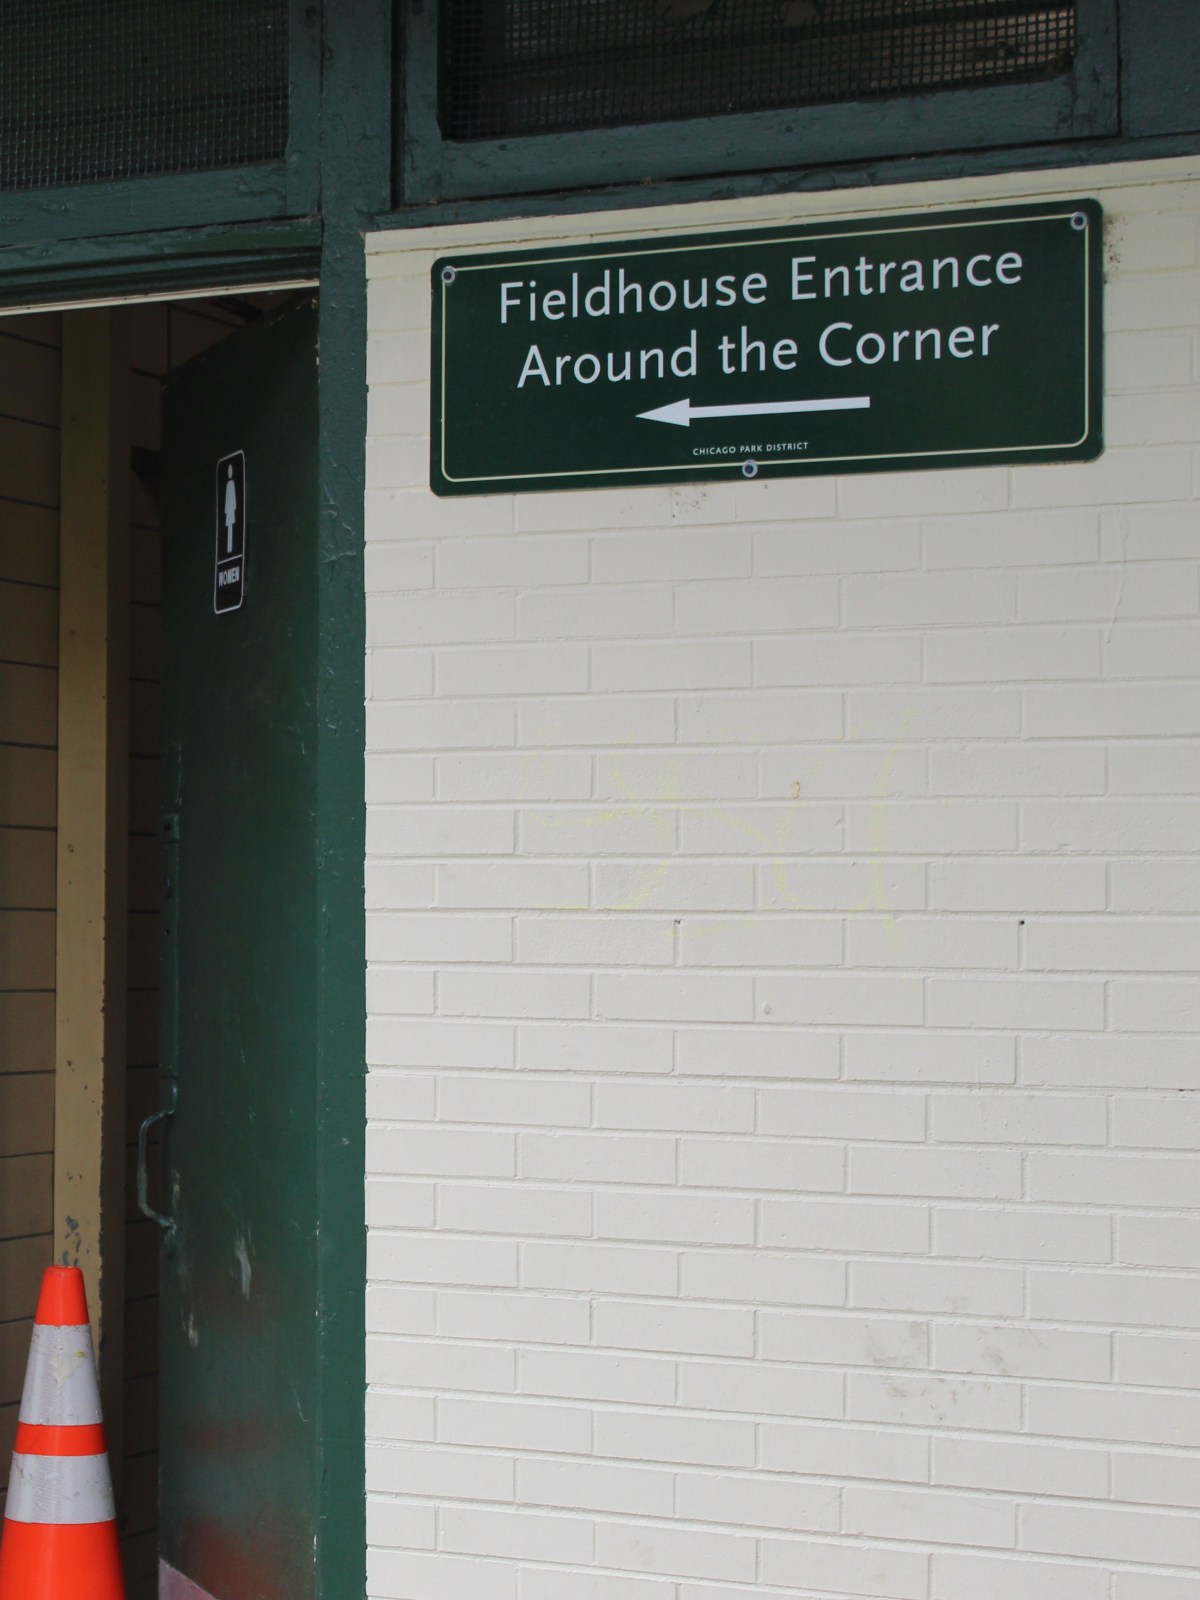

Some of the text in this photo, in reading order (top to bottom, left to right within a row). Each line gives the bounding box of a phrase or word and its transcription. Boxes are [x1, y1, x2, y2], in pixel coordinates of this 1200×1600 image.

[501, 252, 1023, 323] Fieldhouse Entrance
[517, 322, 1000, 388] Around the Corner
[693, 442, 809, 456] CHICAGO PARK DISTRICT
[218, 566, 240, 587] WOMEN
